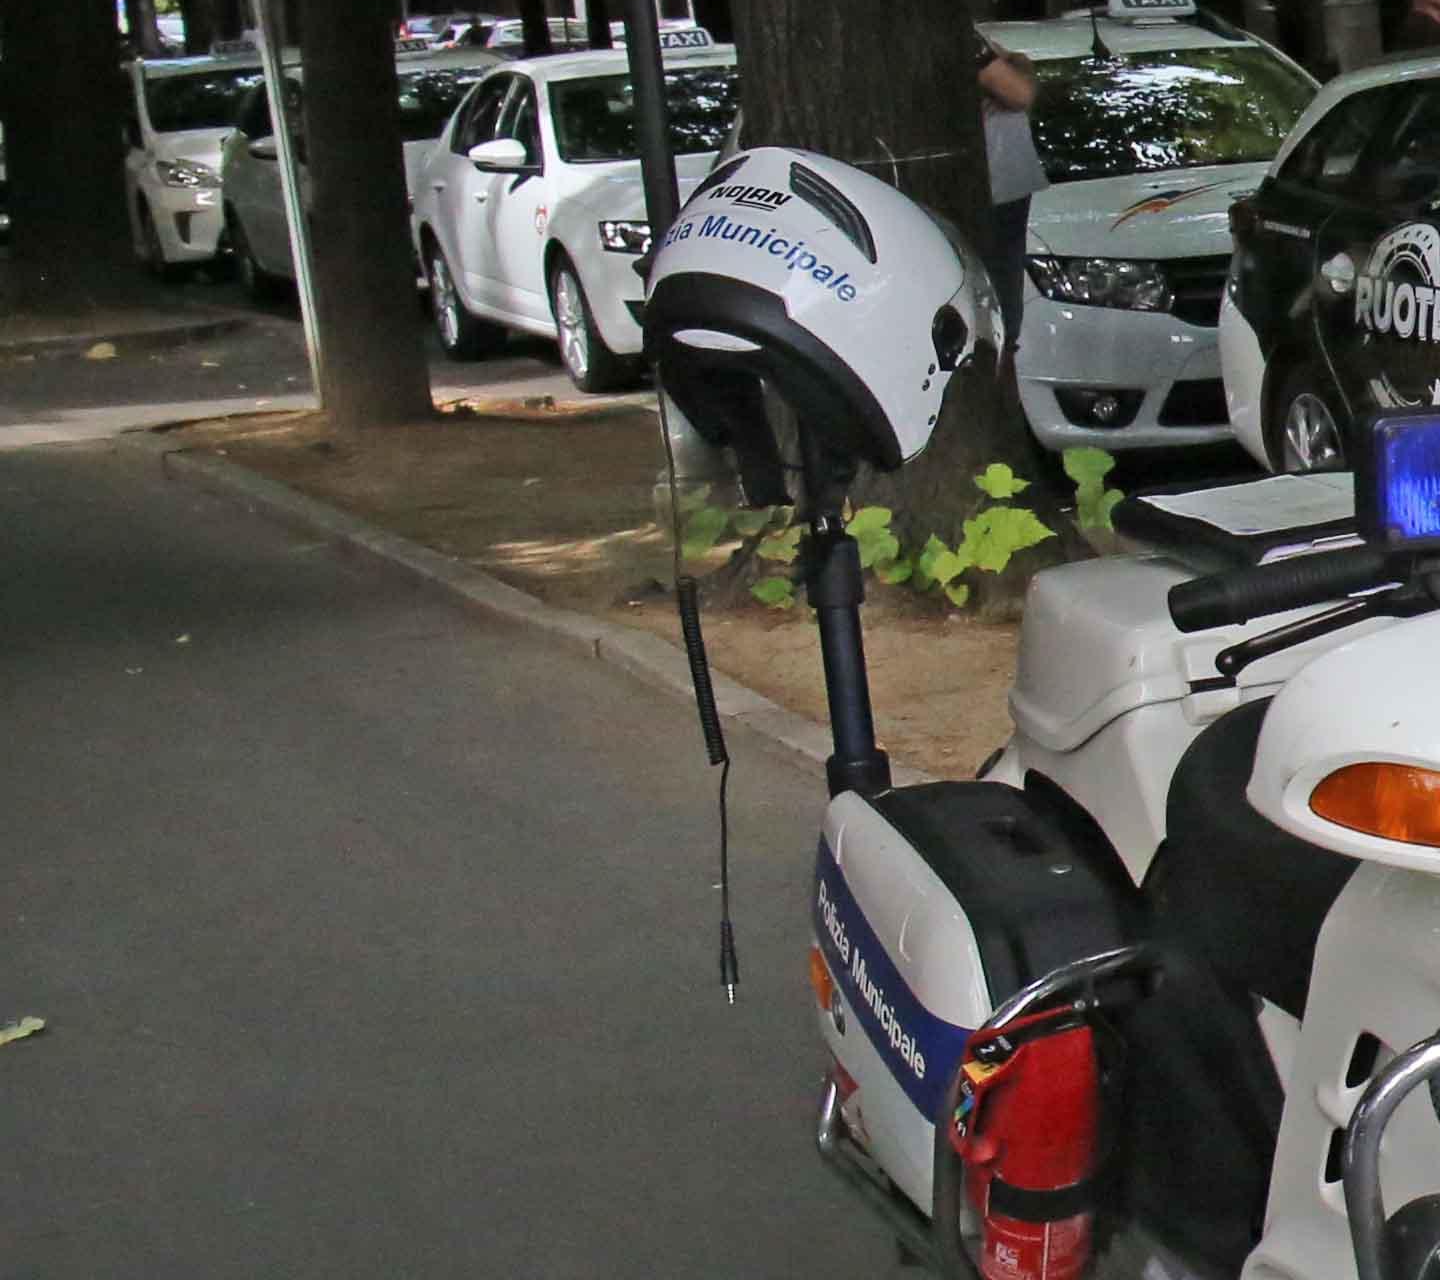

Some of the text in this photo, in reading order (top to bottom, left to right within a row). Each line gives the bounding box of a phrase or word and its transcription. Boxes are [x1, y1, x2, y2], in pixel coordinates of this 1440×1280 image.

[709, 184, 793, 211] NOLAN
[697, 214, 858, 303] Municipale
[817, 878, 926, 1080] Polizia Municipale
